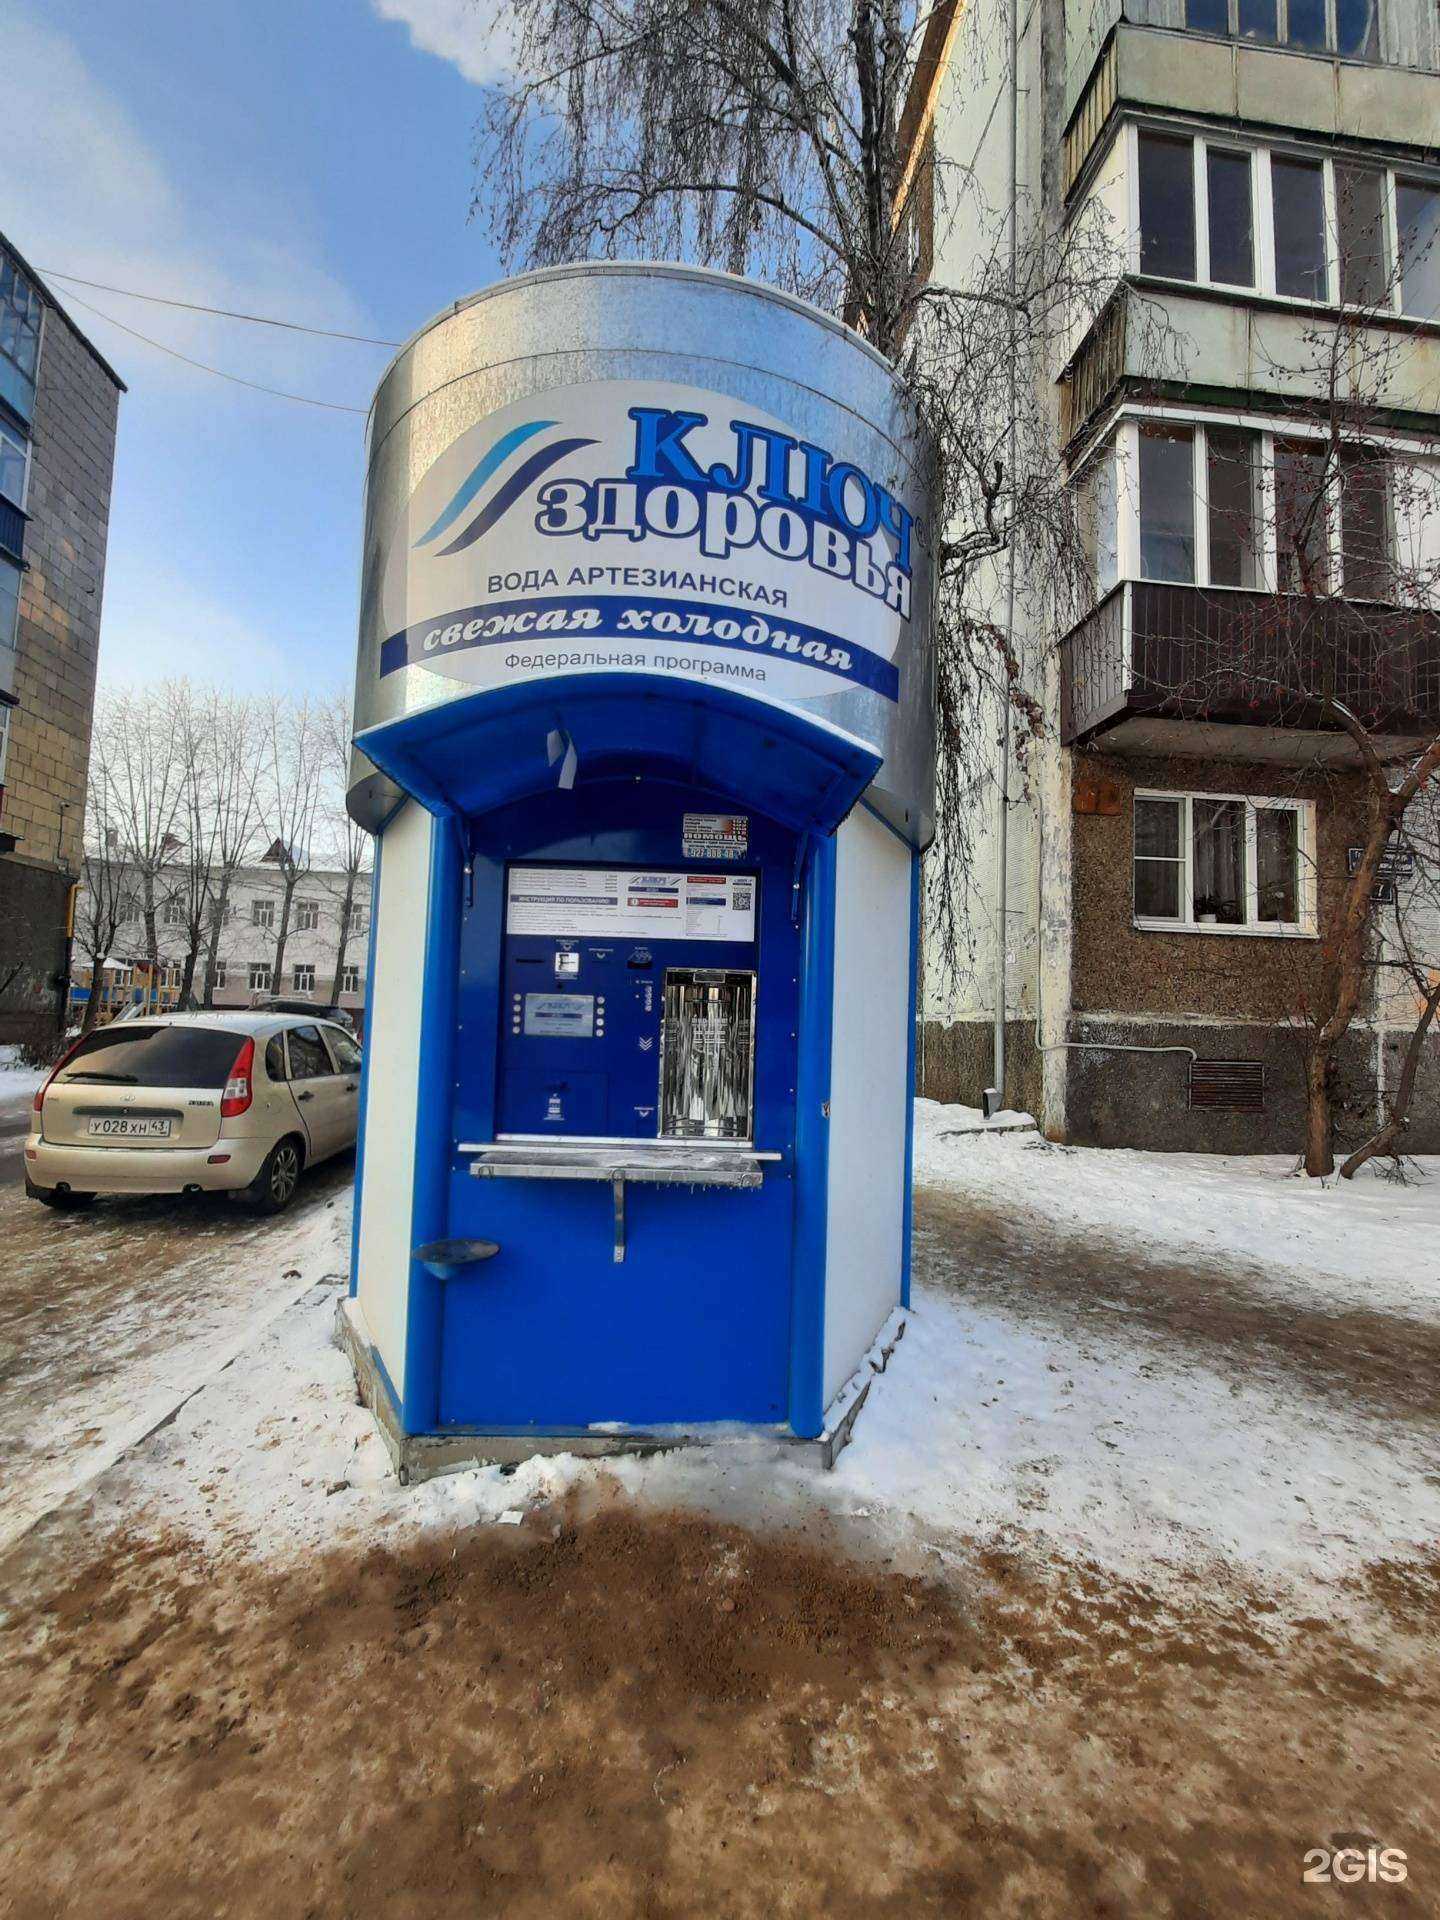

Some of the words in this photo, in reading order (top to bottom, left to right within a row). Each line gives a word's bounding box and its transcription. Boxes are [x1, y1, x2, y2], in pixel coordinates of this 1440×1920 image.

[627, 406, 913, 580] КЛЮЧ
[487, 568, 559, 594] ВОДА
[567, 567, 788, 609] АРТЕЗИАНСКАЯ
[423, 609, 602, 652] свежая
[616, 610, 853, 672] холодная
[504, 650, 646, 670] Федеральная
[654, 656, 767, 683] программа
